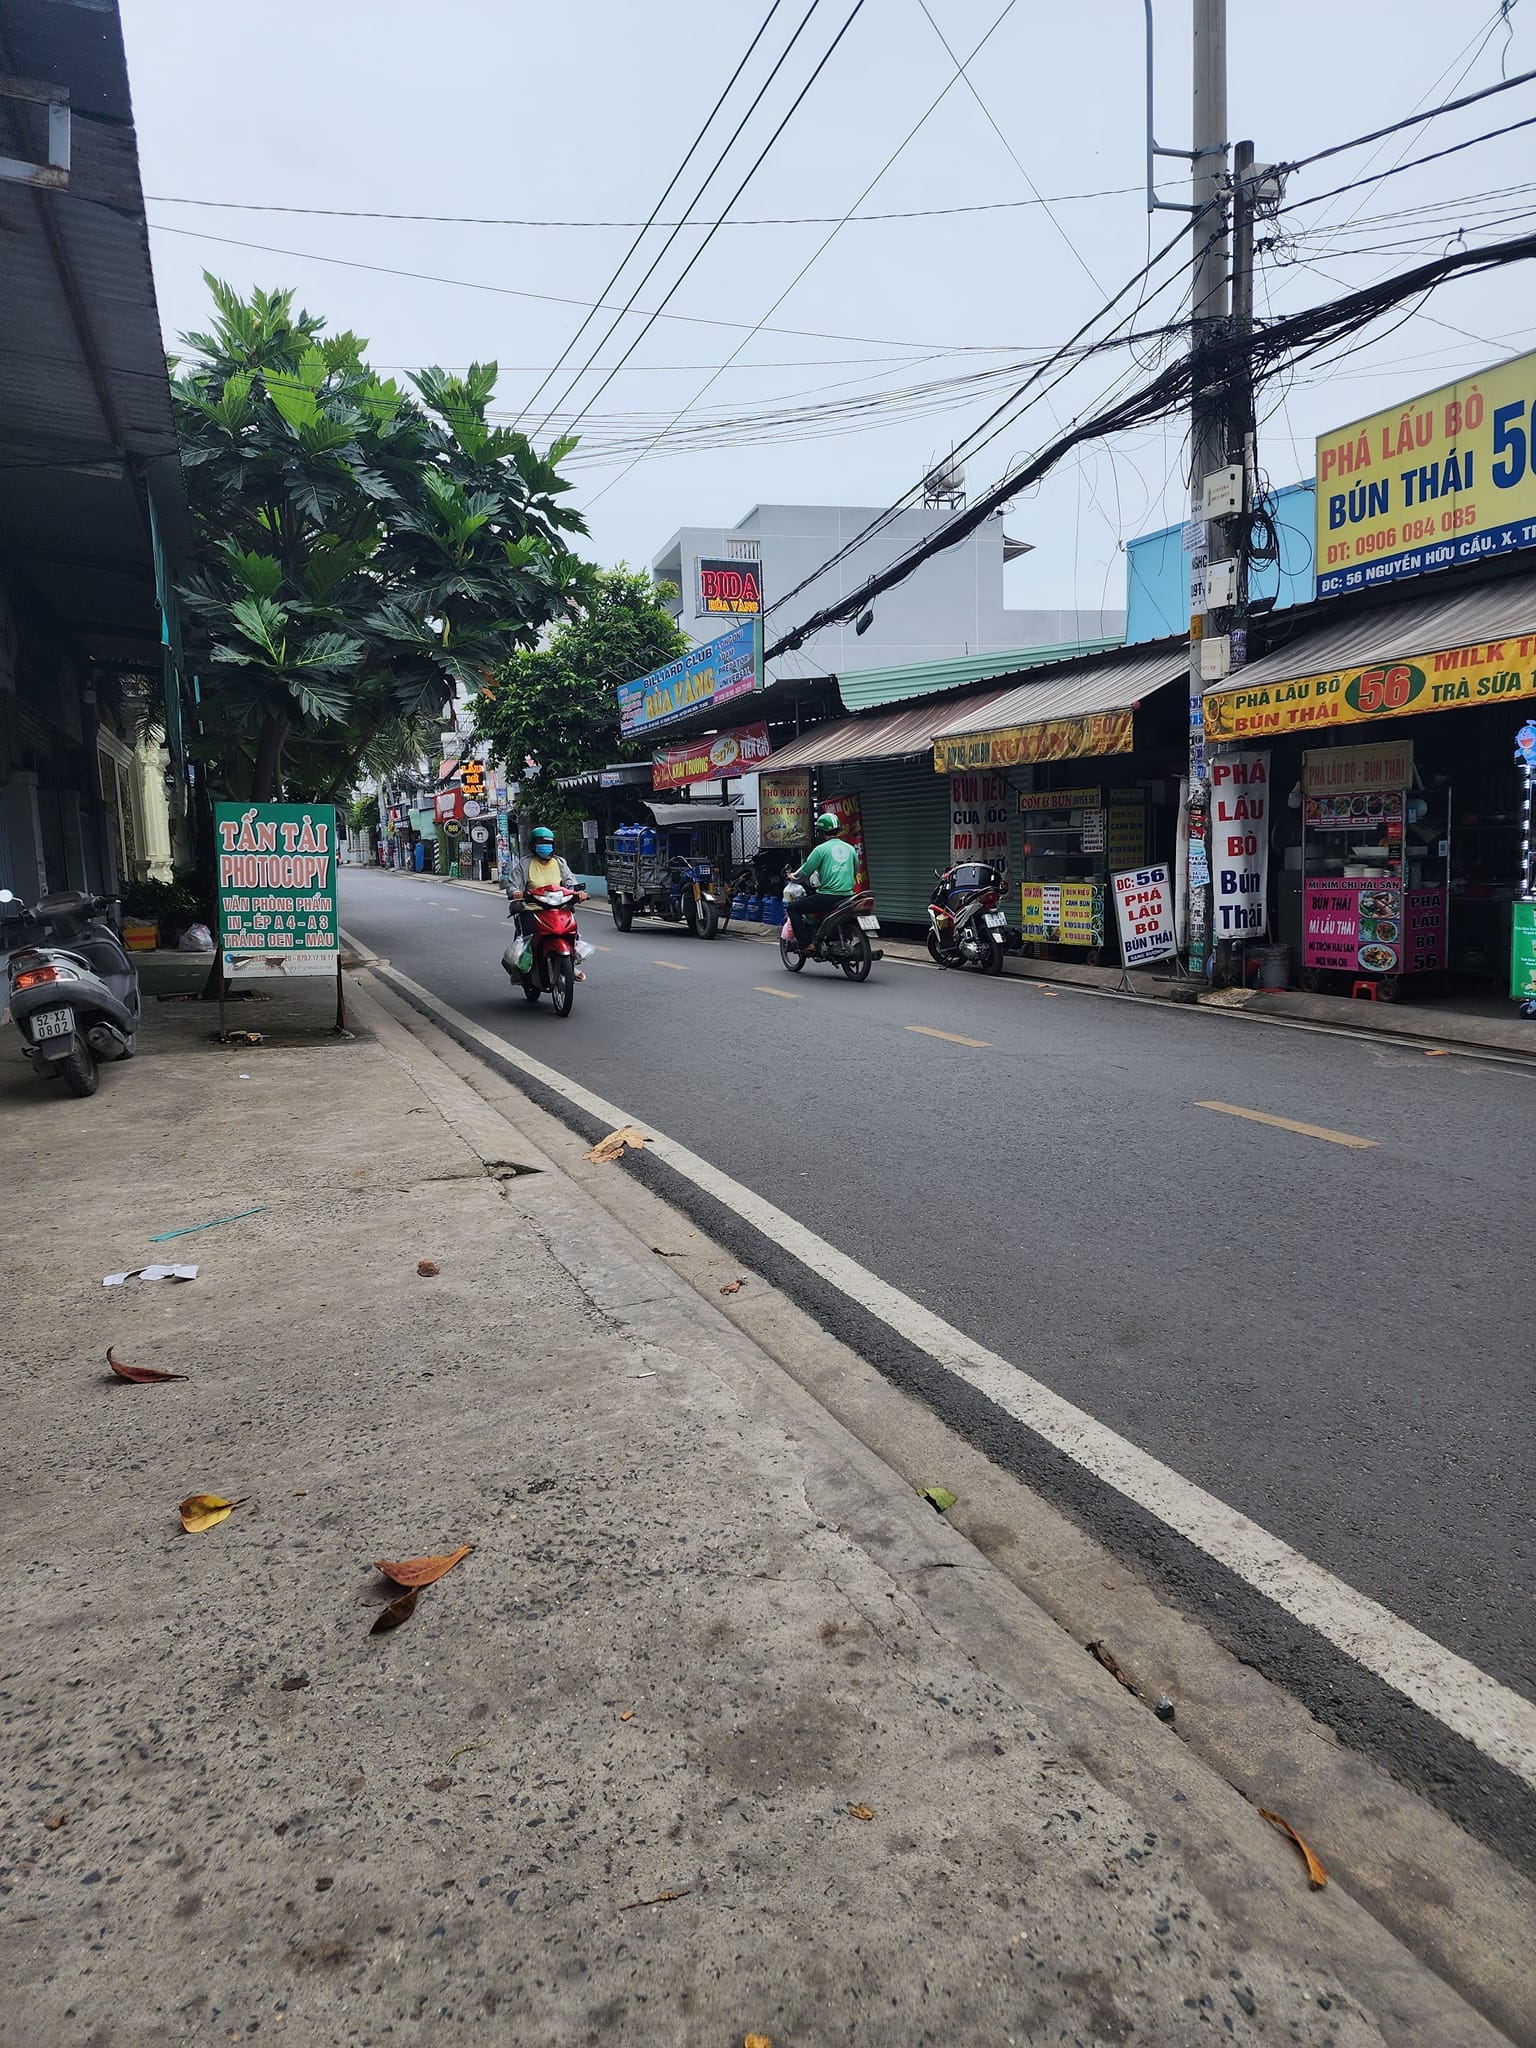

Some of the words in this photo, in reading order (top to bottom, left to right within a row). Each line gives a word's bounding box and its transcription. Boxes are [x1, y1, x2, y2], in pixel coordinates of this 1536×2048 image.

[1321, 429, 1371, 482] PHÁ
[1382, 405, 1433, 460] LẤU
[1444, 385, 1484, 438] BÒ
[1492, 399, 1536, 489] 5
[1329, 479, 1389, 530] BÚN
[1400, 447, 1473, 507] THÁI
[1327, 544, 1350, 565] ĐT:
[1355, 527, 1397, 556] 0906
[1402, 517, 1436, 543] 084
[1441, 504, 1476, 532] 085
[1321, 577, 1343, 592] ĐC:
[1346, 570, 1363, 587] 56
[1501, 530, 1517, 547] X.
[700, 570, 760, 600] BIDA
[731, 598, 758, 613] VÀNG
[643, 661, 683, 689] BILLIARD
[685, 647, 713, 669] CLUB
[1433, 641, 1506, 672] MILK
[673, 668, 715, 708] VÀNG
[1235, 688, 1271, 709] PHÁ
[1275, 680, 1310, 703] LẤU
[1316, 675, 1340, 696] BÒ
[1358, 666, 1411, 712] 56
[1431, 677, 1470, 703] TRÀ
[1476, 671, 1521, 696] SỮA
[1234, 711, 1280, 732] BÚN
[1287, 702, 1339, 723] THÁI
[1213, 758, 1266, 786] PHÁ
[1051, 792, 1073, 807] BÚN
[1218, 792, 1264, 822] LẤU
[953, 810, 980, 825] CUA
[987, 804, 1008, 823] ỐC
[280, 815, 329, 853] TÀI
[954, 831, 972, 850] MÌ
[1227, 830, 1257, 857] BÒ
[220, 854, 329, 889] PHOTOCOPY
[1116, 877, 1135, 891] ĐC:
[1136, 868, 1165, 886] 56
[1220, 868, 1261, 895] Bún
[1321, 881, 1339, 889] KIM
[1342, 881, 1357, 889] CHI
[223, 894, 250, 912] VĂN
[252, 894, 294, 912] PHÒNG
[1124, 887, 1162, 907] PHÁ
[1312, 894, 1329, 911] BÚN
[1331, 893, 1353, 911] THÁI
[1411, 891, 1440, 908] PHÁ
[227, 915, 241, 930] IN
[1128, 903, 1162, 921] LẤU
[1219, 903, 1263, 930] Thái
[223, 928, 265, 948] TRẮNG
[267, 932, 294, 948] ĐEN
[305, 929, 335, 948] MÀU
[1135, 918, 1160, 935] BÒ
[1309, 917, 1320, 934] MÌ
[1336, 918, 1356, 936] THÁI
[1124, 937, 1148, 953] BÚN
[1149, 930, 1173, 946] THÁI
[1414, 953, 1437, 970] 56
[37, 1010, 66, 1026] 52-X2
[39, 1021, 69, 1038] 0802
